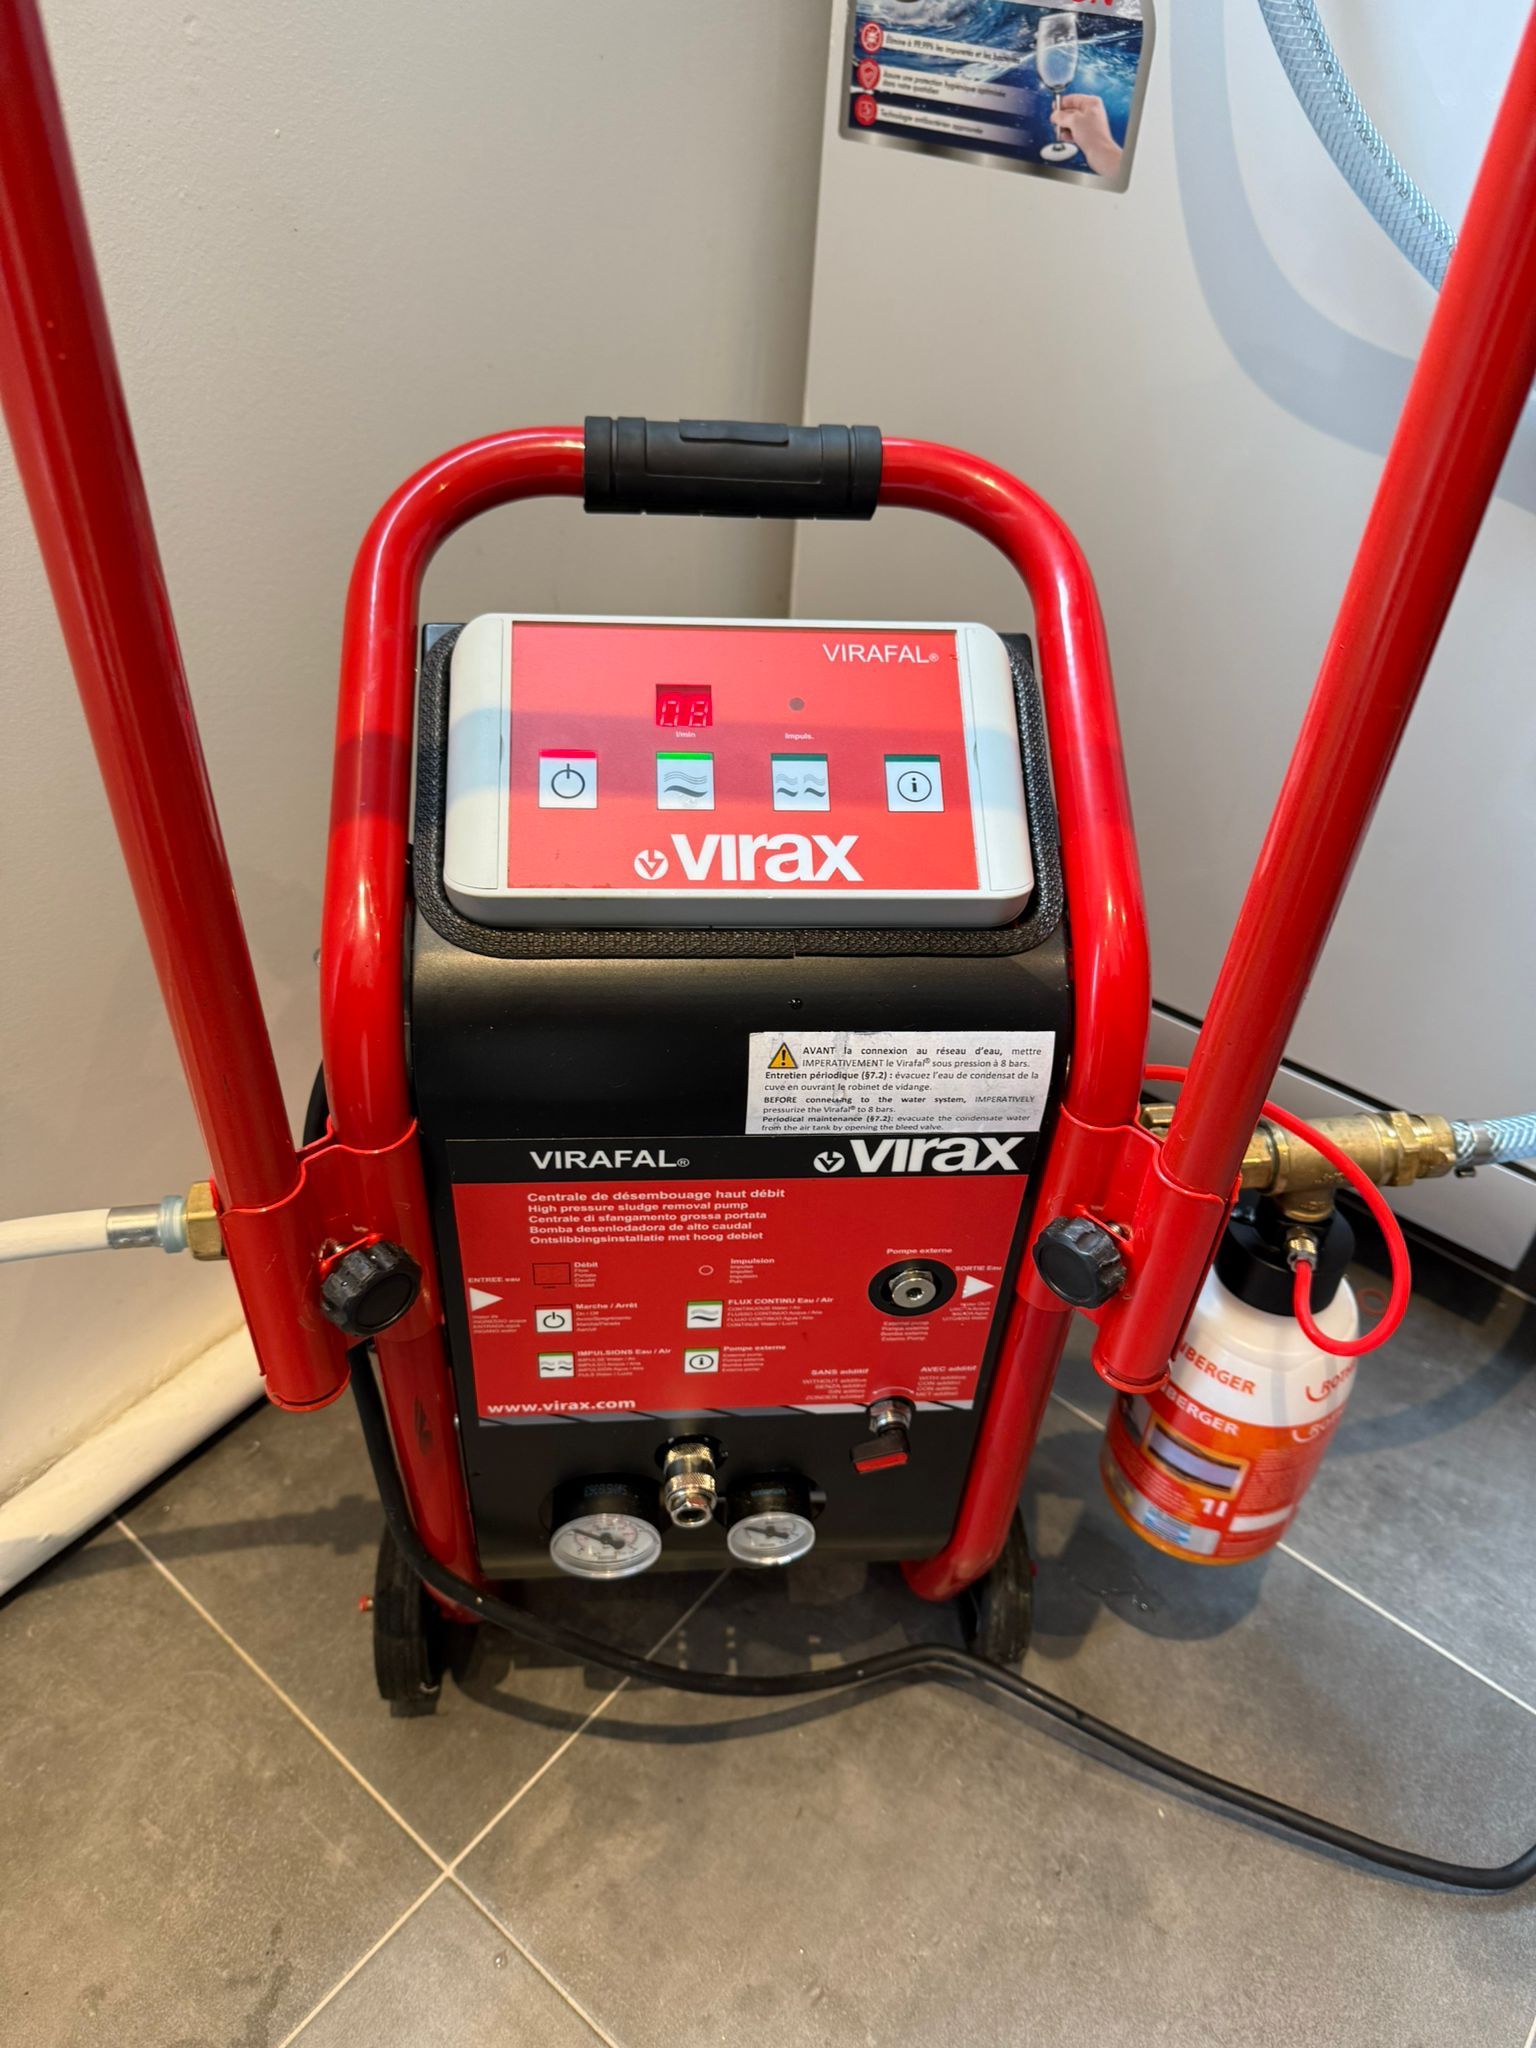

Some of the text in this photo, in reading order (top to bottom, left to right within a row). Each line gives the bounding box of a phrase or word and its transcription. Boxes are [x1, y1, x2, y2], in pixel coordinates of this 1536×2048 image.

[784, 732, 814, 741] Impuls.
[670, 833, 864, 882] virax
[802, 1046, 836, 1055] AVANT
[844, 1046, 852, 1055] la
[861, 1046, 908, 1055] connexion
[936, 1046, 966, 1055] réseau
[1012, 1048, 1042, 1056] mettre
[802, 1059, 884, 1068] IMPERATIVEMENT
[886, 1058, 894, 1068] le
[932, 1060, 952, 1068] sous
[954, 1060, 991, 1069] pression
[993, 1059, 999, 1068] à
[1000, 1060, 1006, 1068] 8
[1008, 1058, 1030, 1068] bars.
[765, 1072, 807, 1080] Entretien
[810, 1072, 859, 1081] périodique
[861, 1072, 888, 1080] (§7.2)
[895, 1072, 931, 1080] évacuez
[956, 1072, 968, 1080] de
[970, 1072, 1015, 1080] condensat
[1017, 1072, 1028, 1080] de
[1031, 1072, 1039, 1080] la
[895, 1083, 932, 1092] vidange.
[764, 1096, 797, 1104] BEFORE
[878, 1096, 892, 1104] the
[901, 1096, 926, 1104] water
[763, 1106, 806, 1114] pressurize
[833, 1124, 843, 1132] by
[845, 1124, 878, 1132] opening
[850, 1136, 1026, 1173] virax
[527, 1189, 786, 1202] Centrale de désembouage haut débit
[528, 1202, 748, 1214] High pressure sludge removal pump
[528, 1212, 767, 1223] Centrale di sfangamento grossa portata
[529, 1222, 752, 1234] Bomba desenlodadora de alto caudal
[530, 1234, 665, 1244] Ontslibbingsinstallatie
[693, 1233, 724, 1242] hoog
[726, 1232, 764, 1240] debiet
[886, 1248, 918, 1256] Pompe
[487, 1399, 636, 1413] www.virax.com
